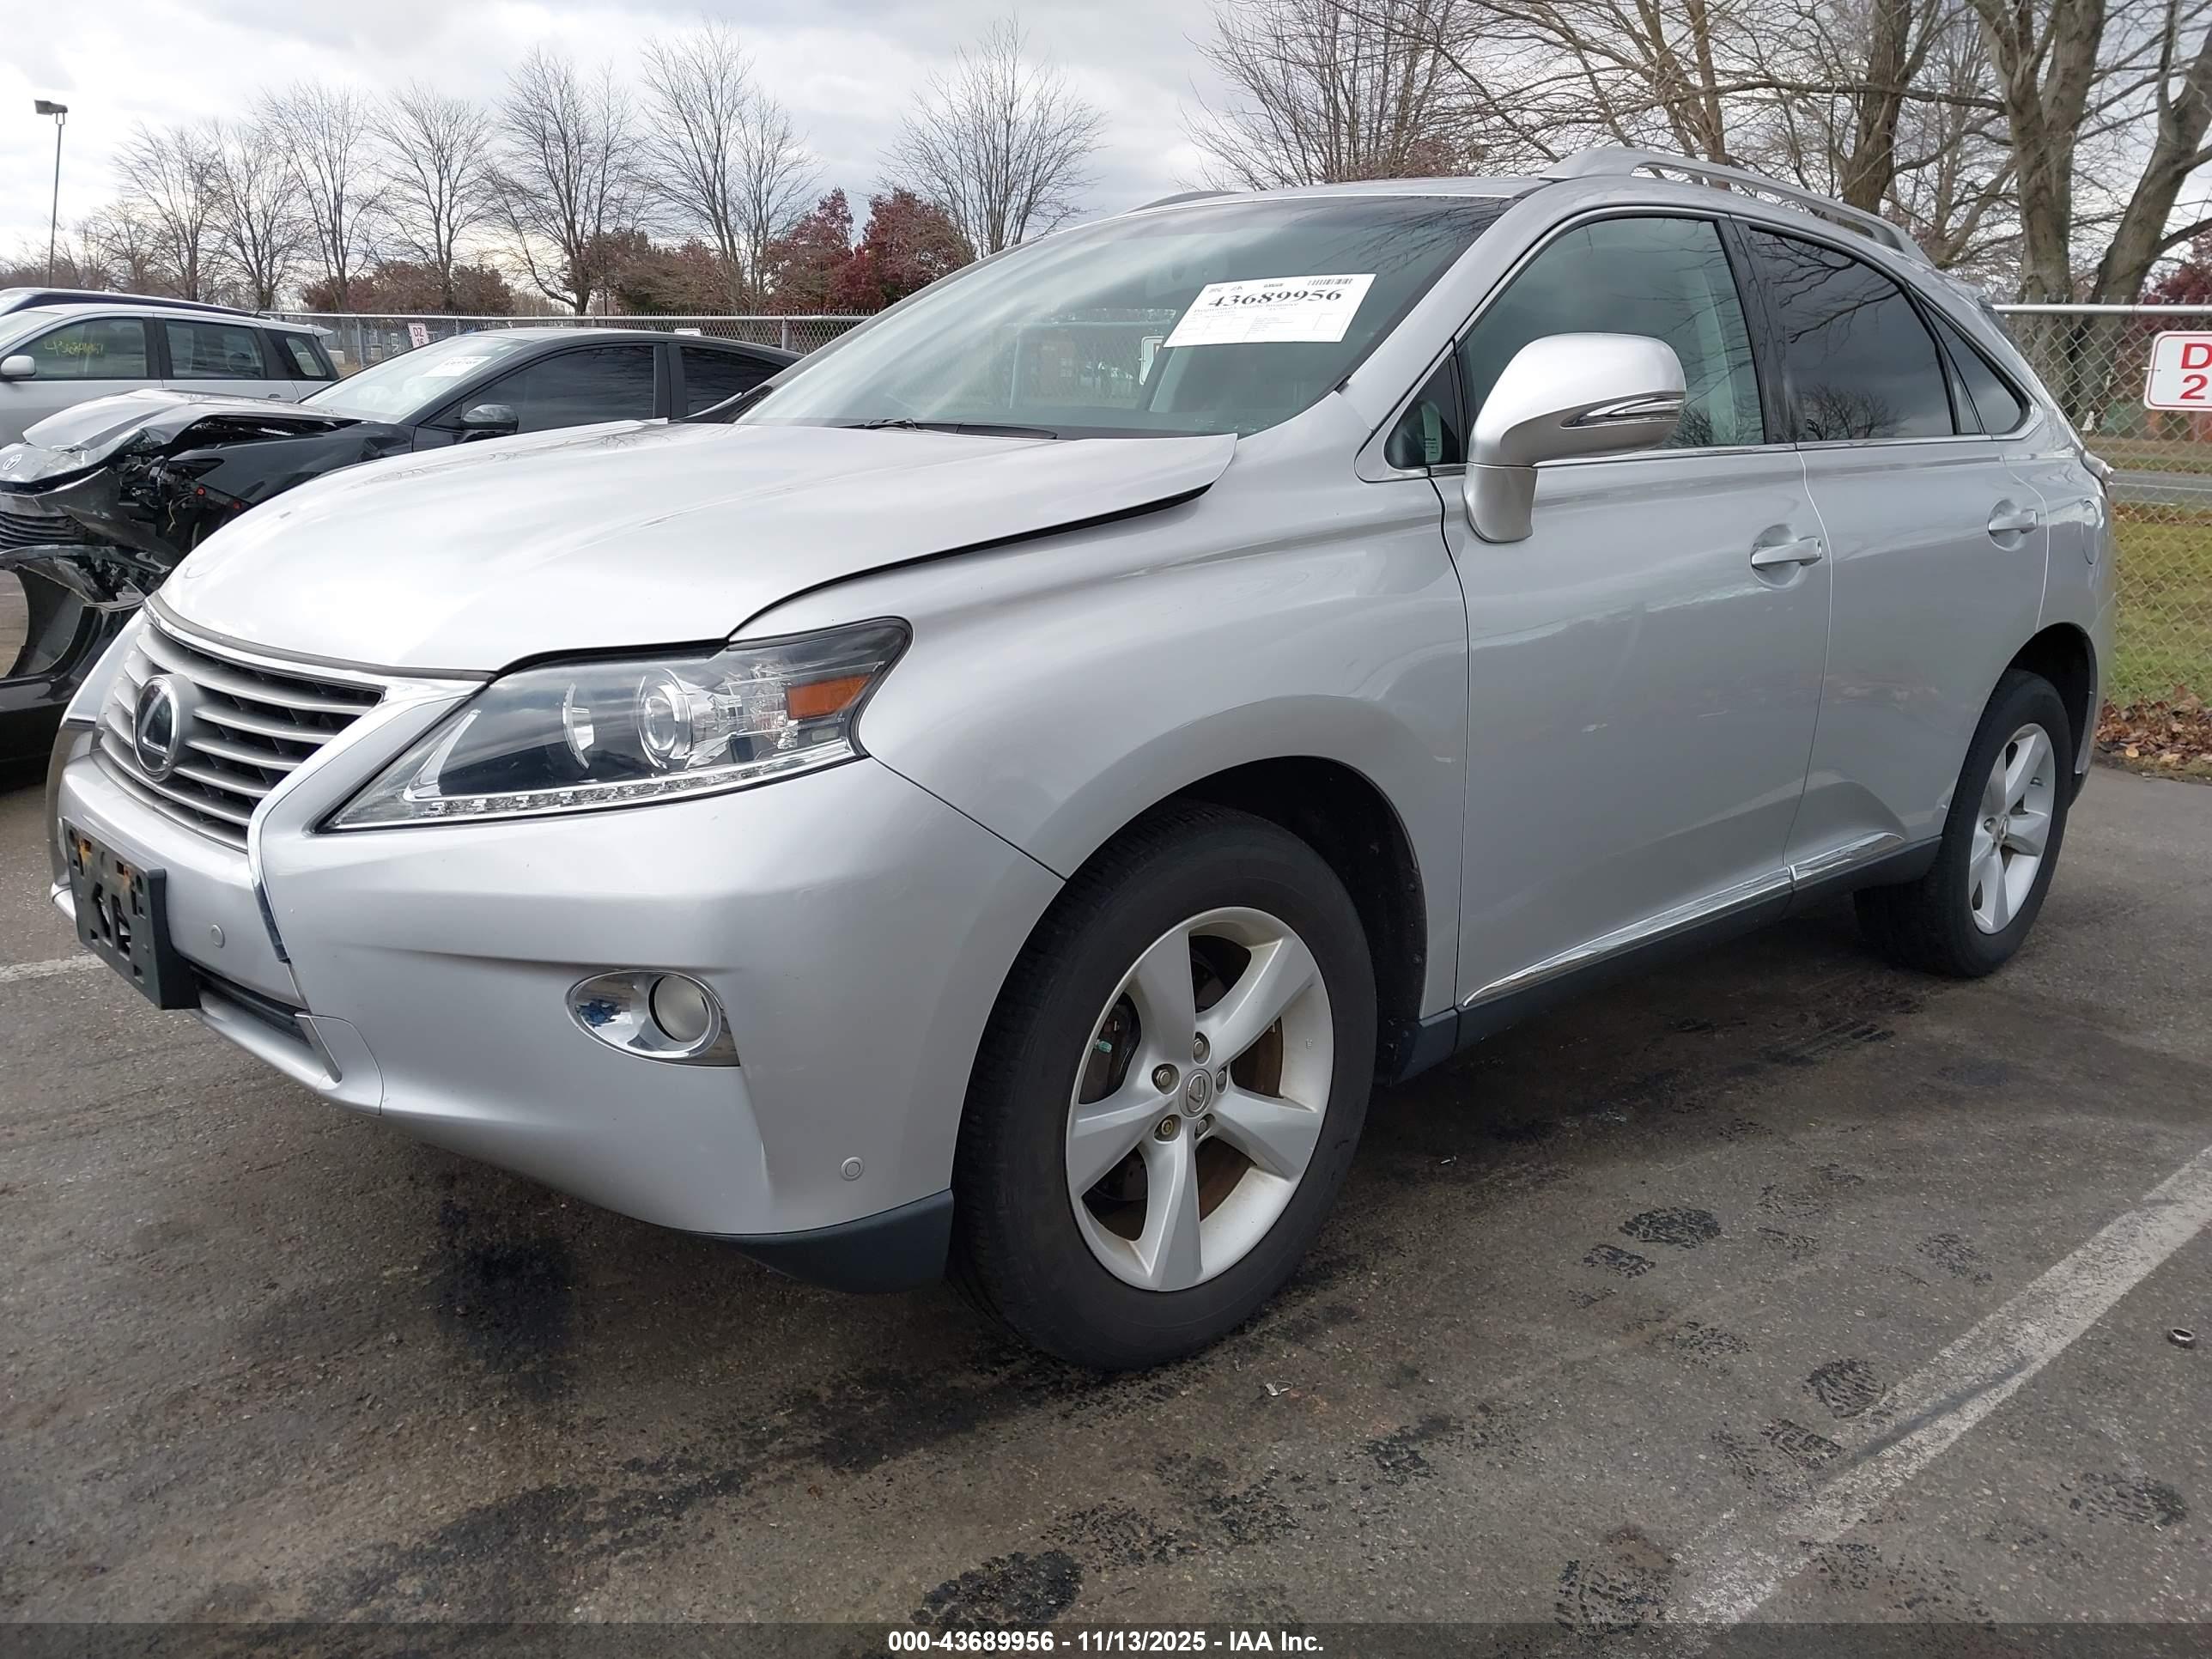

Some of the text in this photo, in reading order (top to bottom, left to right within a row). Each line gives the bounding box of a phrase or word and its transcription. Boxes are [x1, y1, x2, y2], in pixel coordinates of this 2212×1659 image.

[1209, 289, 1344, 307] 43689956
[413, 327, 424, 337] DZ
[2179, 374, 2208, 400] 2
